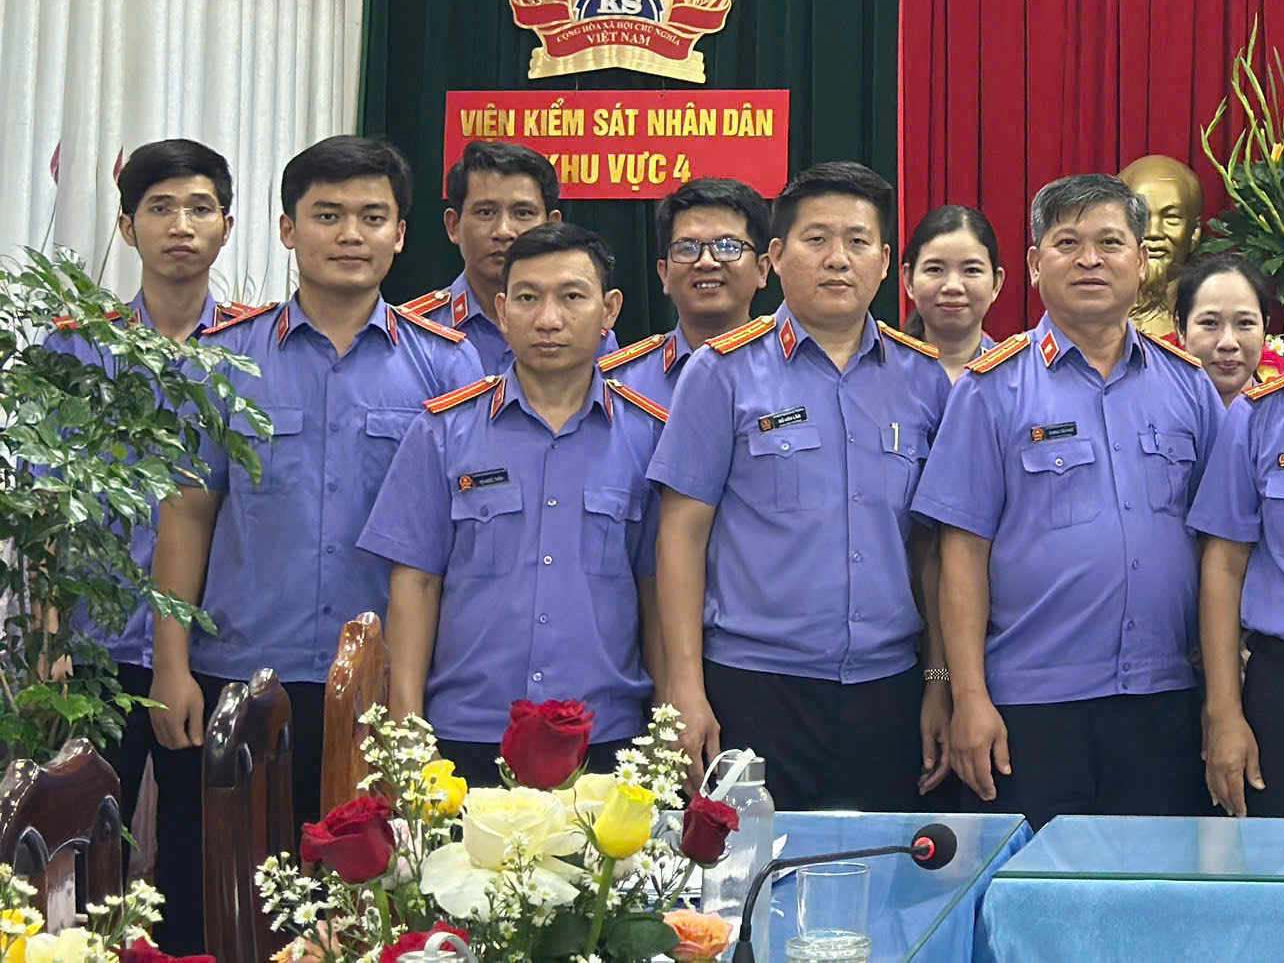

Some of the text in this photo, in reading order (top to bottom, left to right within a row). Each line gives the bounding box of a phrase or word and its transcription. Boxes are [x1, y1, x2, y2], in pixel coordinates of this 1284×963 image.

[586, 29, 651, 46] VIỆT NAM
[523, 97, 585, 137] KIỂM
[592, 102, 639, 137] SÁT
[647, 102, 717, 137] NHÂN
[722, 102, 774, 137] DÂN
[607, 150, 667, 191] VỰC
[673, 154, 692, 183] 4
